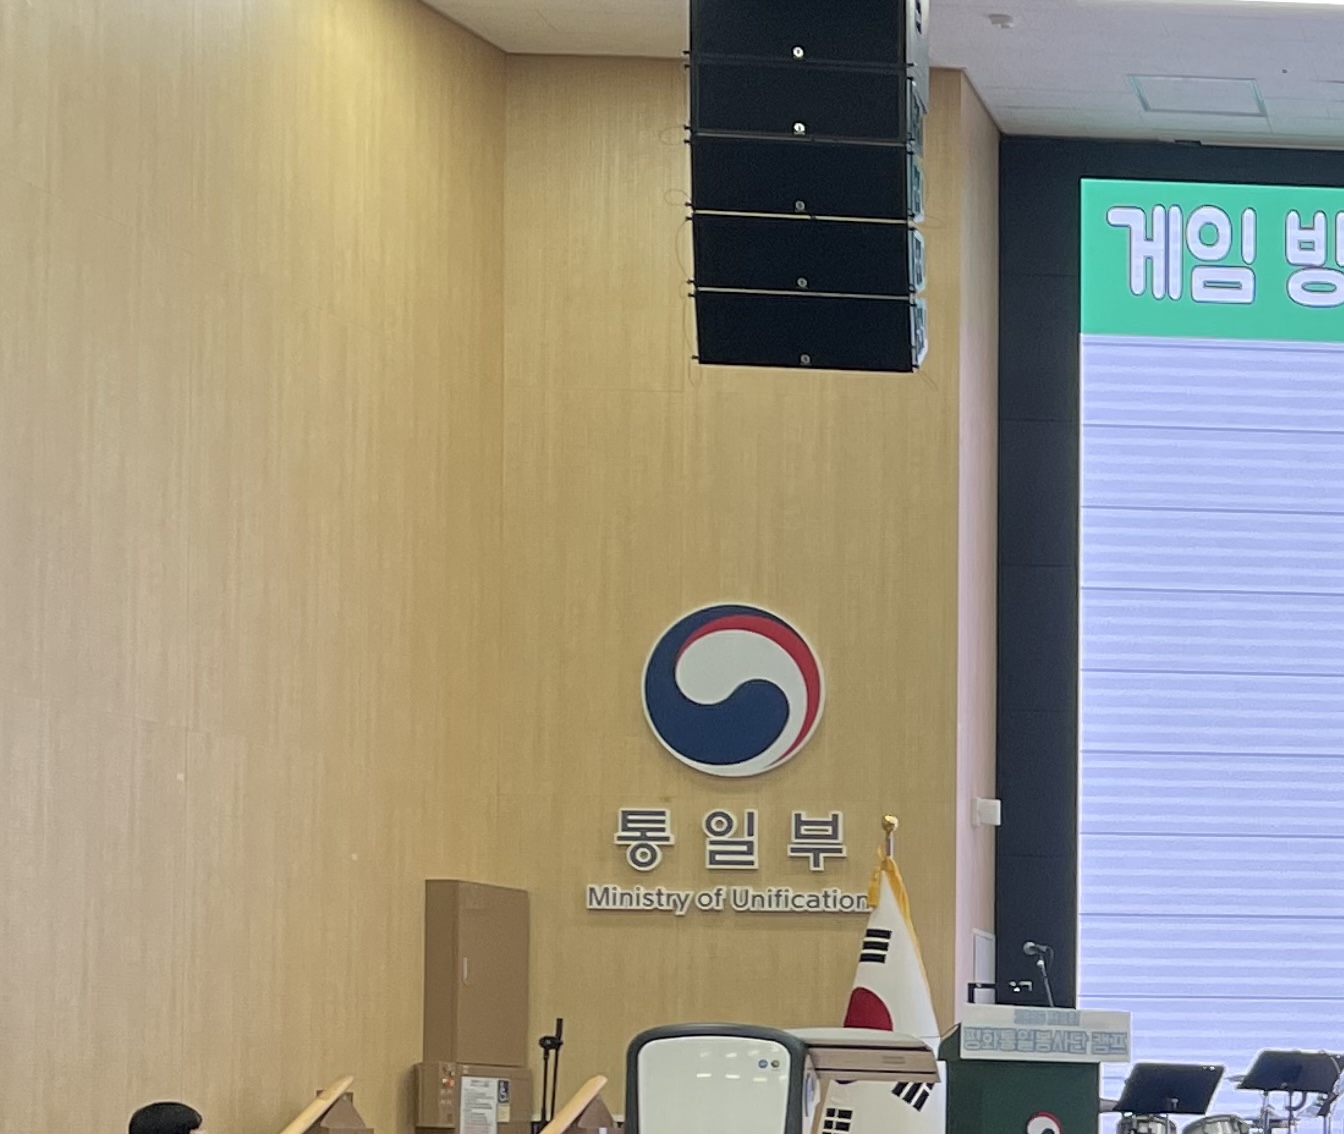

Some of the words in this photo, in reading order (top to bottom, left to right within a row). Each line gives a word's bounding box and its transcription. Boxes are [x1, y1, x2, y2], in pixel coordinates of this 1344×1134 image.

[1106, 204, 1256, 304] 게임
[587, 885, 690, 915] Ministry
[697, 887, 725, 910] of
[733, 887, 870, 912] Unification
